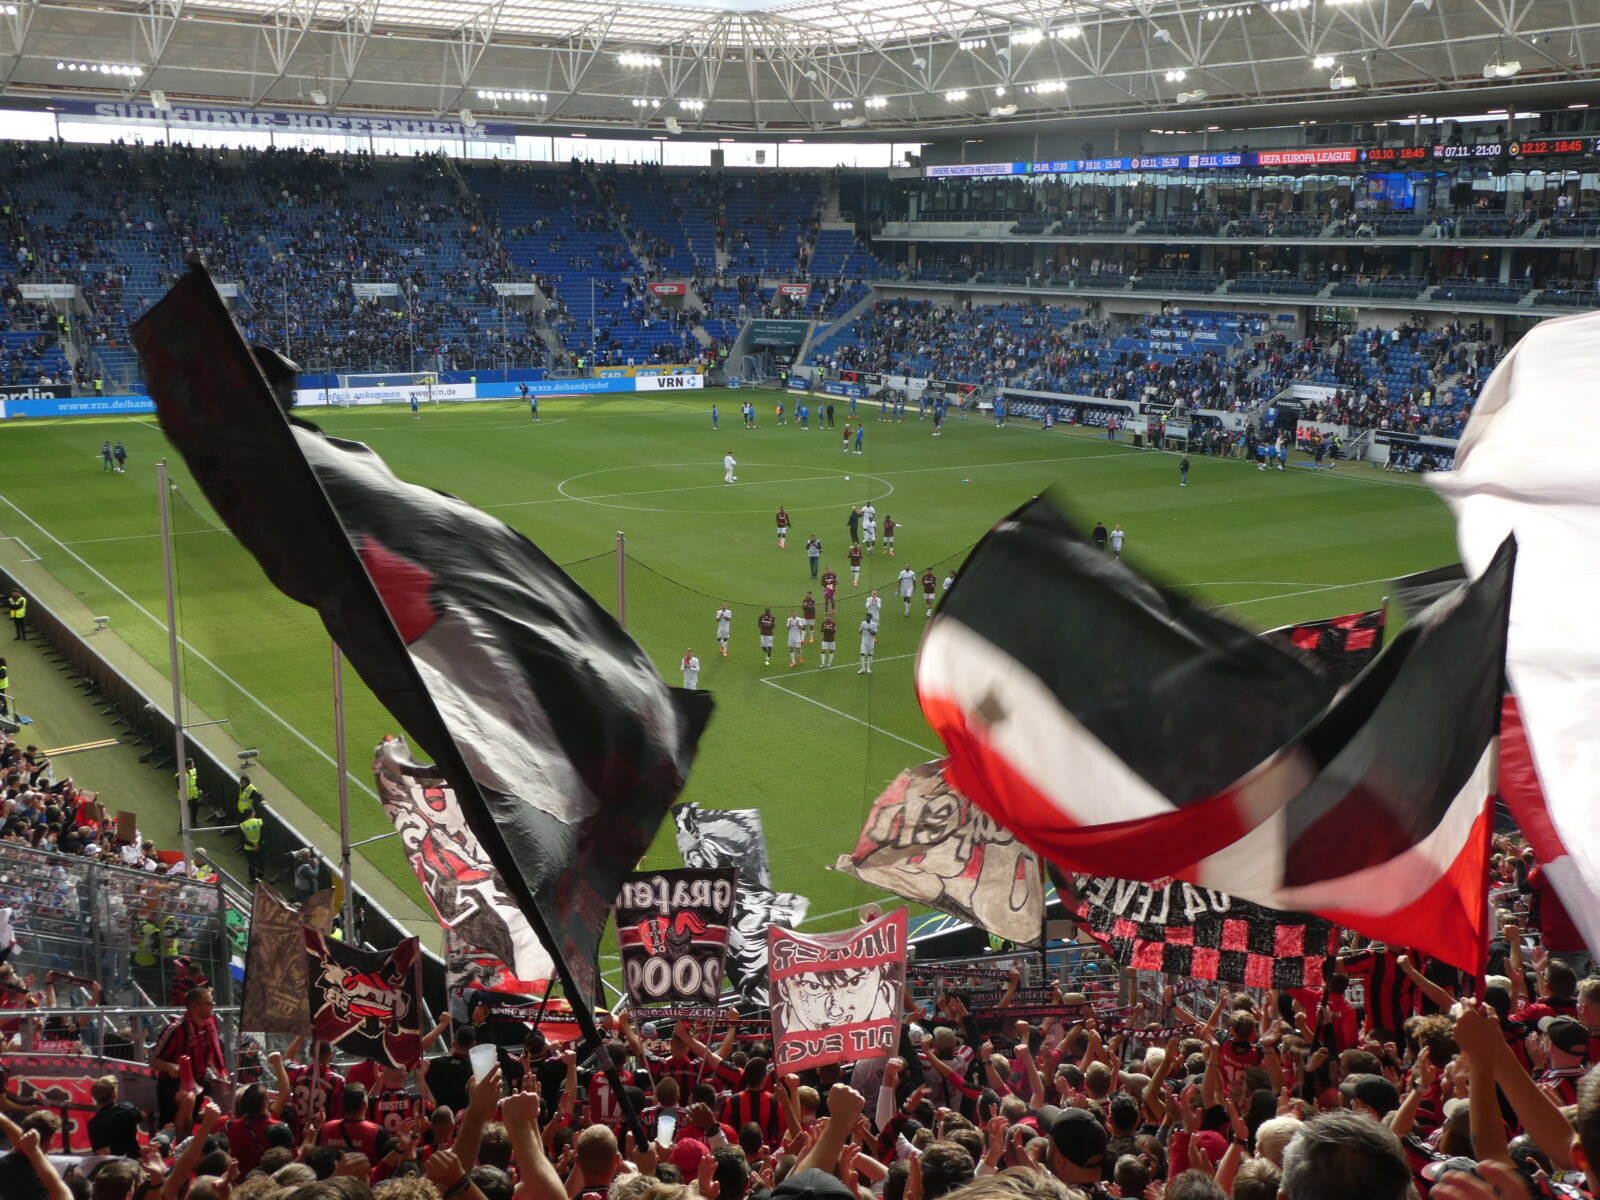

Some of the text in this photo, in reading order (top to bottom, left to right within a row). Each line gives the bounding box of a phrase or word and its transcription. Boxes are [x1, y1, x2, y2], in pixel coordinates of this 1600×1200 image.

[286, 114, 487, 139] HOFFENHEIM
[1476, 144, 1501, 156] 21:00
[1555, 140, 1582, 152] 18:45
[1260, 151, 1351, 164] UEFA EUROPA LEAGUE
[1400, 148, 1425, 158] 18:45
[1161, 158, 1179, 167] 15:30
[1222, 155, 1241, 165] 15:30
[514, 381, 609, 393] ww.vrn.de/handyticket
[658, 377, 684, 388] VRN
[353, 391, 400, 400] ankommen
[378, 1099, 409, 1112] KIRSTEN
